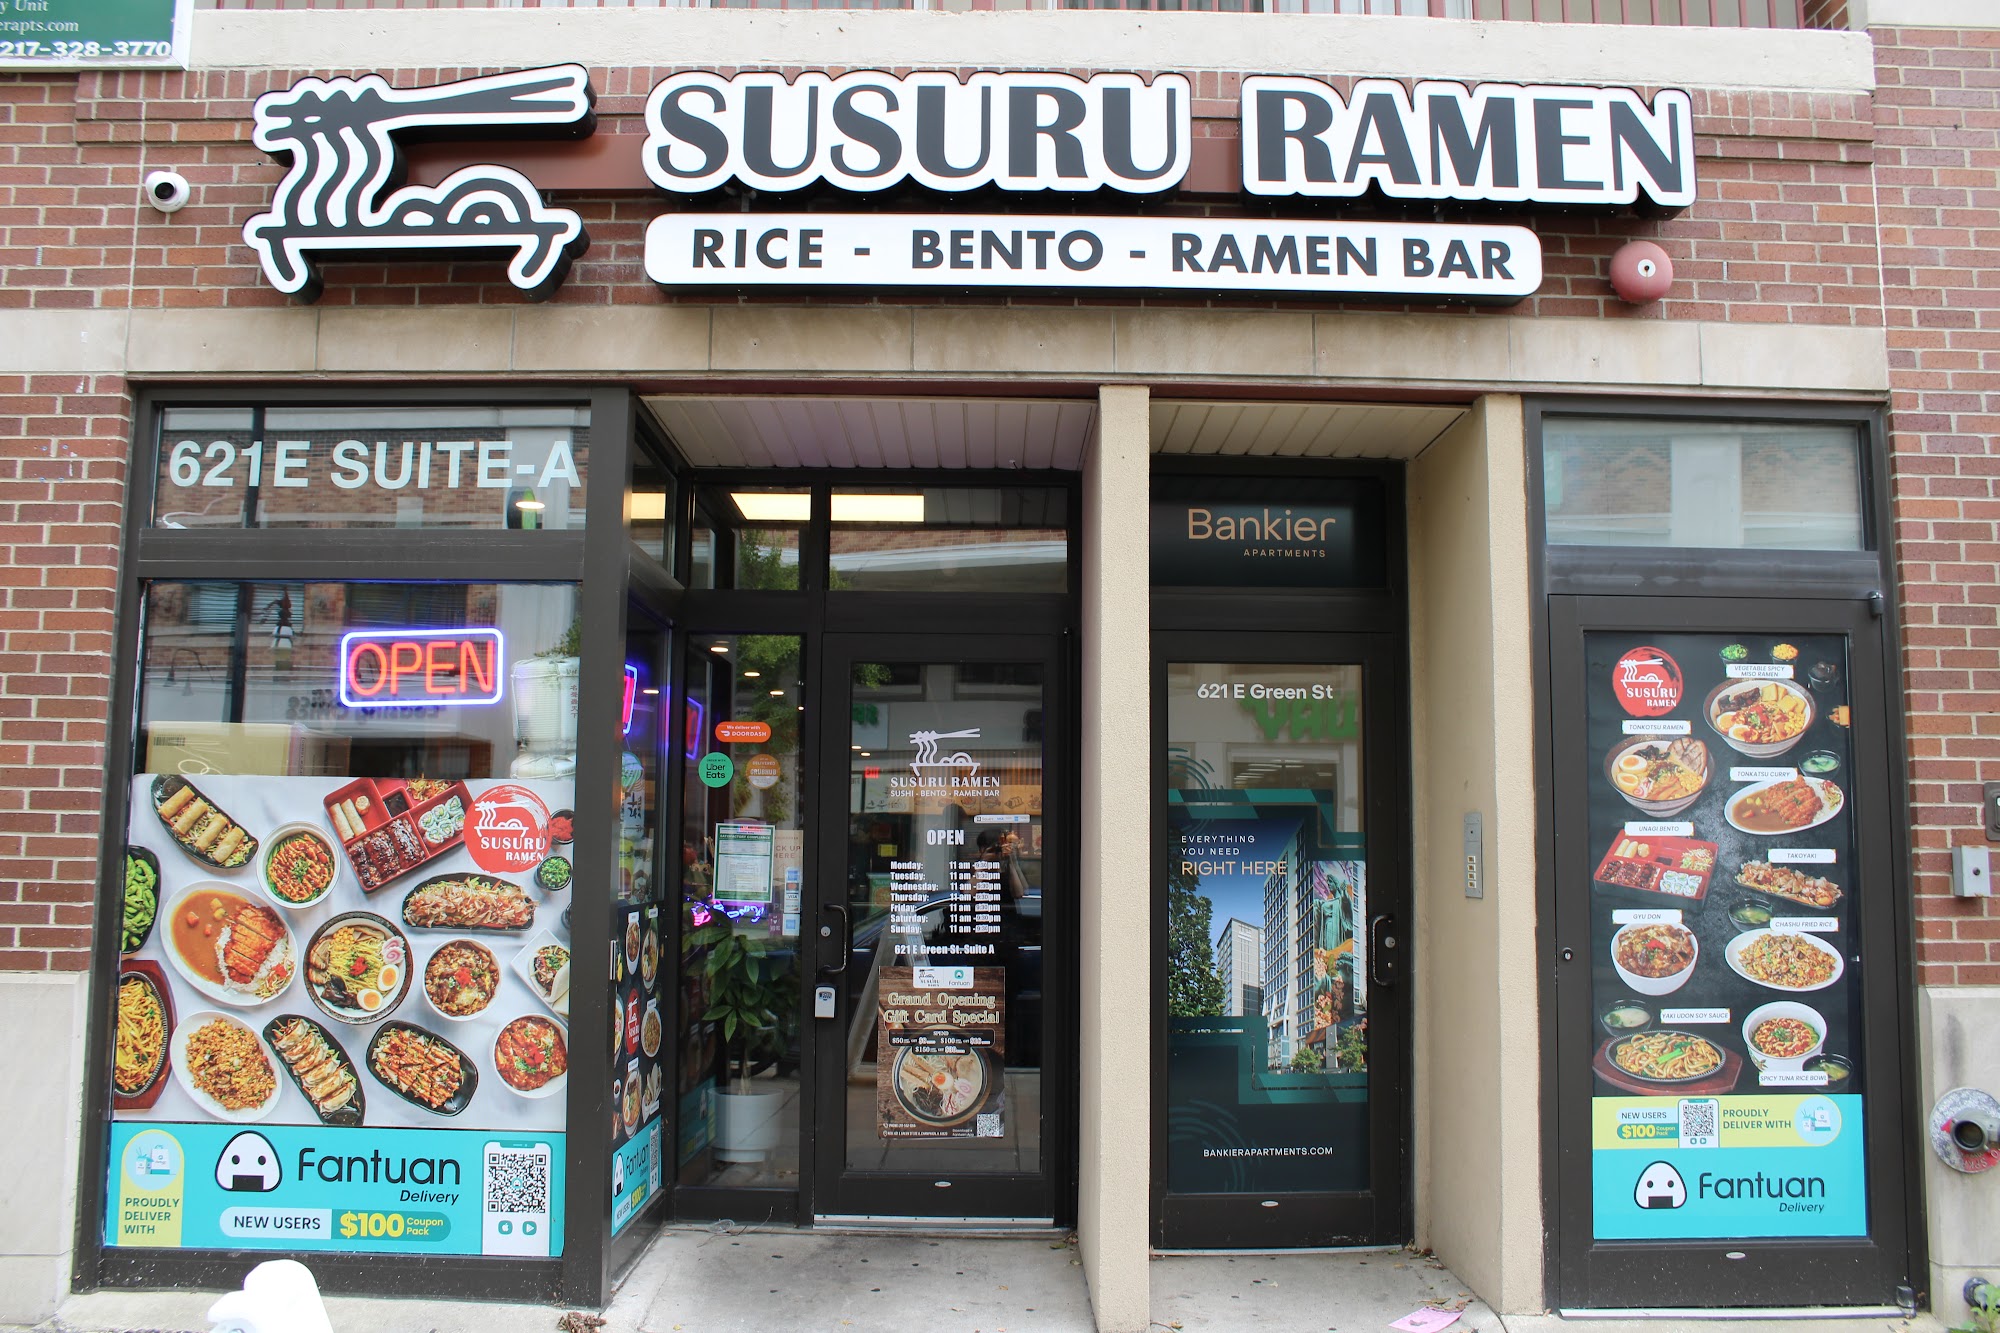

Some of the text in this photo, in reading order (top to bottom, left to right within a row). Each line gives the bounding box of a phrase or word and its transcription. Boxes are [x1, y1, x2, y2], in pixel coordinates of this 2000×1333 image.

[15, 0, 49, 12] Unit
[657, 84, 1684, 193] SUSURU RAMEN
[692, 228, 824, 269] RICE
[912, 230, 1103, 271] BENTO
[1172, 233, 1378, 276] RAMEN
[1403, 239, 1515, 280] BAR
[331, 440, 581, 489] SUITE-A
[1188, 508, 1336, 542] Bankier
[1243, 548, 1326, 558] APARTMENTS
[348, 639, 497, 697] OPEN
[1197, 683, 1334, 699] 621 E Green St
[1626, 687, 1677, 698] SUSURU
[1646, 699, 1677, 707] RAMEN
[706, 763, 726, 771] Uber
[706, 771, 726, 779] Eats
[890, 777, 1000, 788] SUSURU RAMEN
[480, 835, 547, 850] SUSURU
[926, 829, 965, 846] OPEN
[1181, 835, 1256, 843] EVERYTHING
[505, 851, 545, 863] RAMEN
[1181, 847, 1240, 856] YOU NEED
[890, 861, 924, 870] Monday:
[958, 861, 970, 869] am
[1181, 860, 1288, 876] RIGHT HERE
[890, 872, 925, 881] Tuesday:
[959, 872, 971, 880] am
[890, 882, 939, 891] Wednesday:
[960, 882, 971, 891] am
[890, 893, 930, 902] Thursday:
[960, 894, 971, 902] am
[890, 903, 917, 913] Friday:
[959, 904, 971, 912] am
[890, 914, 929, 924] Saturday:
[960, 915, 971, 923] am
[890, 925, 922, 934] Sunday:
[959, 926, 971, 934] am
[894, 945, 912, 955] 621
[912, 945, 918, 955] E
[920, 945, 948, 955] Green
[964, 945, 987, 955] Suite
[988, 945, 995, 955] A
[887, 992, 996, 1009] Grand Opening
[884, 1009, 1000, 1026] Gift Card Special
[1621, 1111, 1667, 1120] NEW USERS
[1723, 1108, 1769, 1118] PROUDLY
[1723, 1120, 1792, 1129] DELIVER WITH
[1621, 1124, 1656, 1139] $100
[1203, 1147, 1333, 1158] BANKIERAPARTMENTS.COM
[298, 1147, 461, 1185] Fantuan
[625, 1143, 650, 1179] Fantuan
[1699, 1171, 1825, 1199] Fantuan
[125, 1197, 180, 1208] PROUDLY
[400, 1189, 460, 1206] Delivery
[1779, 1202, 1825, 1213] Delivery
[124, 1211, 171, 1221] DELIVER
[234, 1211, 405, 1239] NEW USERS $100
[406, 1217, 444, 1227] Coupon
[124, 1224, 155, 1234] WITH
[406, 1227, 429, 1236] Pack
